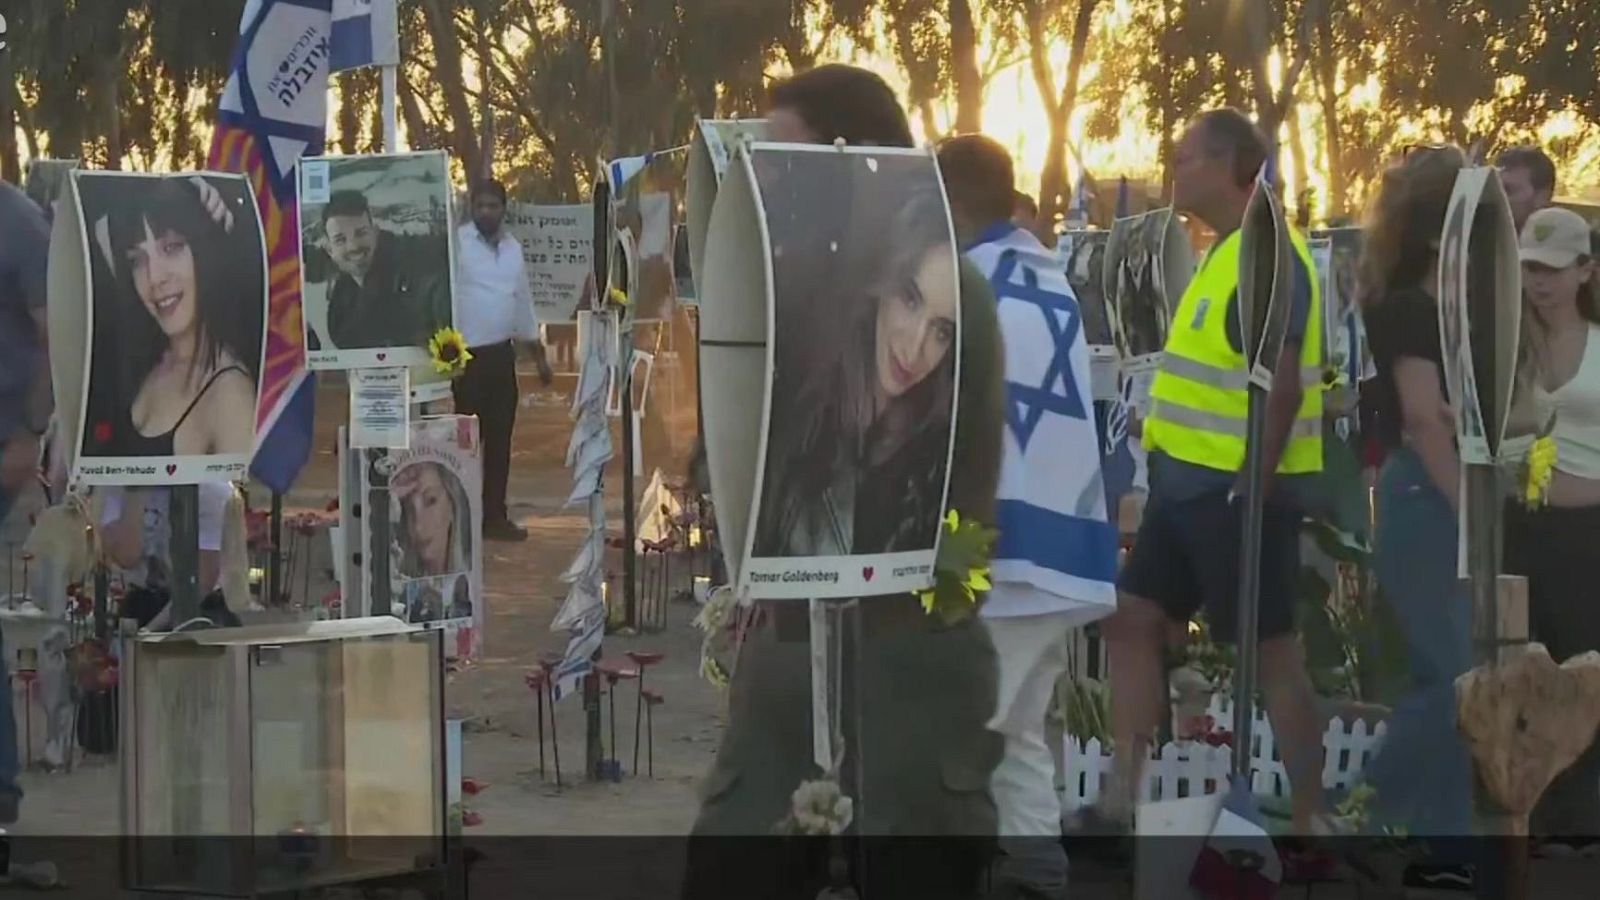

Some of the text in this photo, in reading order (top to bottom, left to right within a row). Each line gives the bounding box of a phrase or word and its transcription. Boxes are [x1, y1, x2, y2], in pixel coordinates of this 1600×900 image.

[278, 36, 332, 108] איזבלה
[569, 239, 594, 250] יים
[782, 570, 839, 584] Goldenberg
